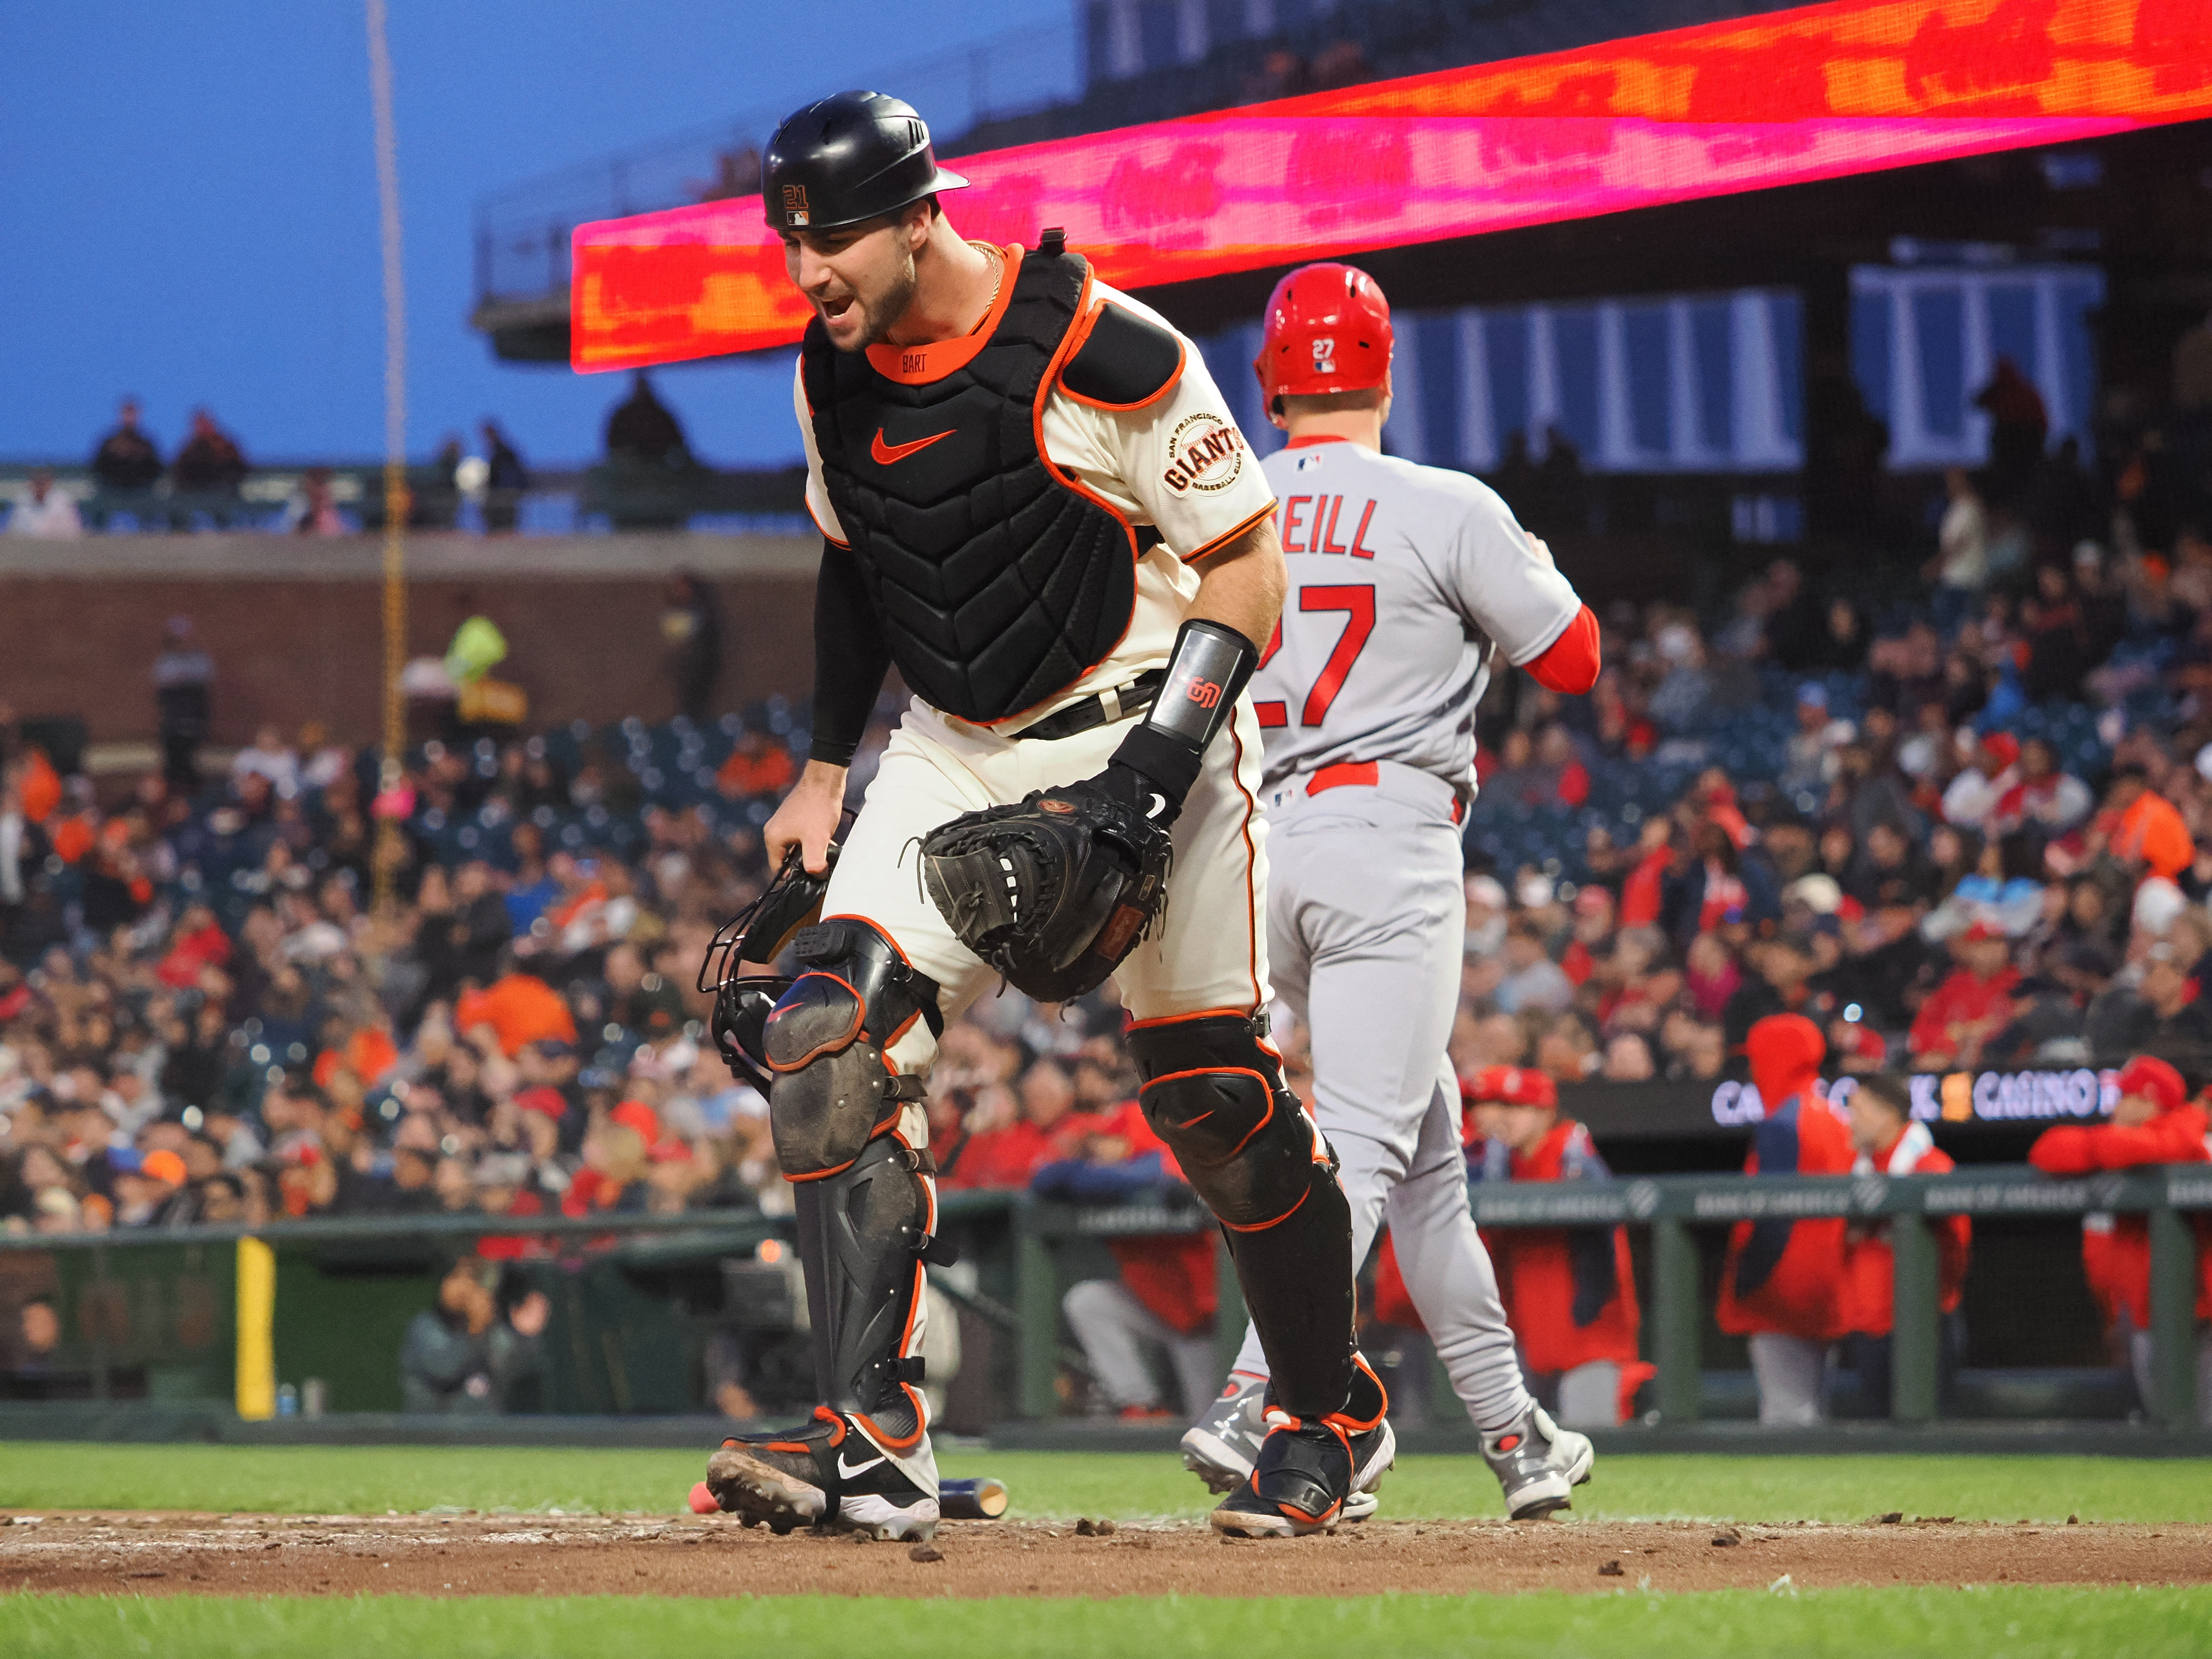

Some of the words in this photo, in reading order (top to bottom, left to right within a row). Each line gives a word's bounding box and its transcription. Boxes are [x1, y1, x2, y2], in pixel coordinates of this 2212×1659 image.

[782, 185, 809, 209] 21
[1313, 338, 1335, 359] 27
[903, 353, 928, 373] BART
[1174, 413, 1223, 436] FRANCISCO
[1192, 477, 1236, 491] BASEBALL
[1270, 494, 1377, 560] EILL
[1973, 1068, 2100, 1121] CASINO
